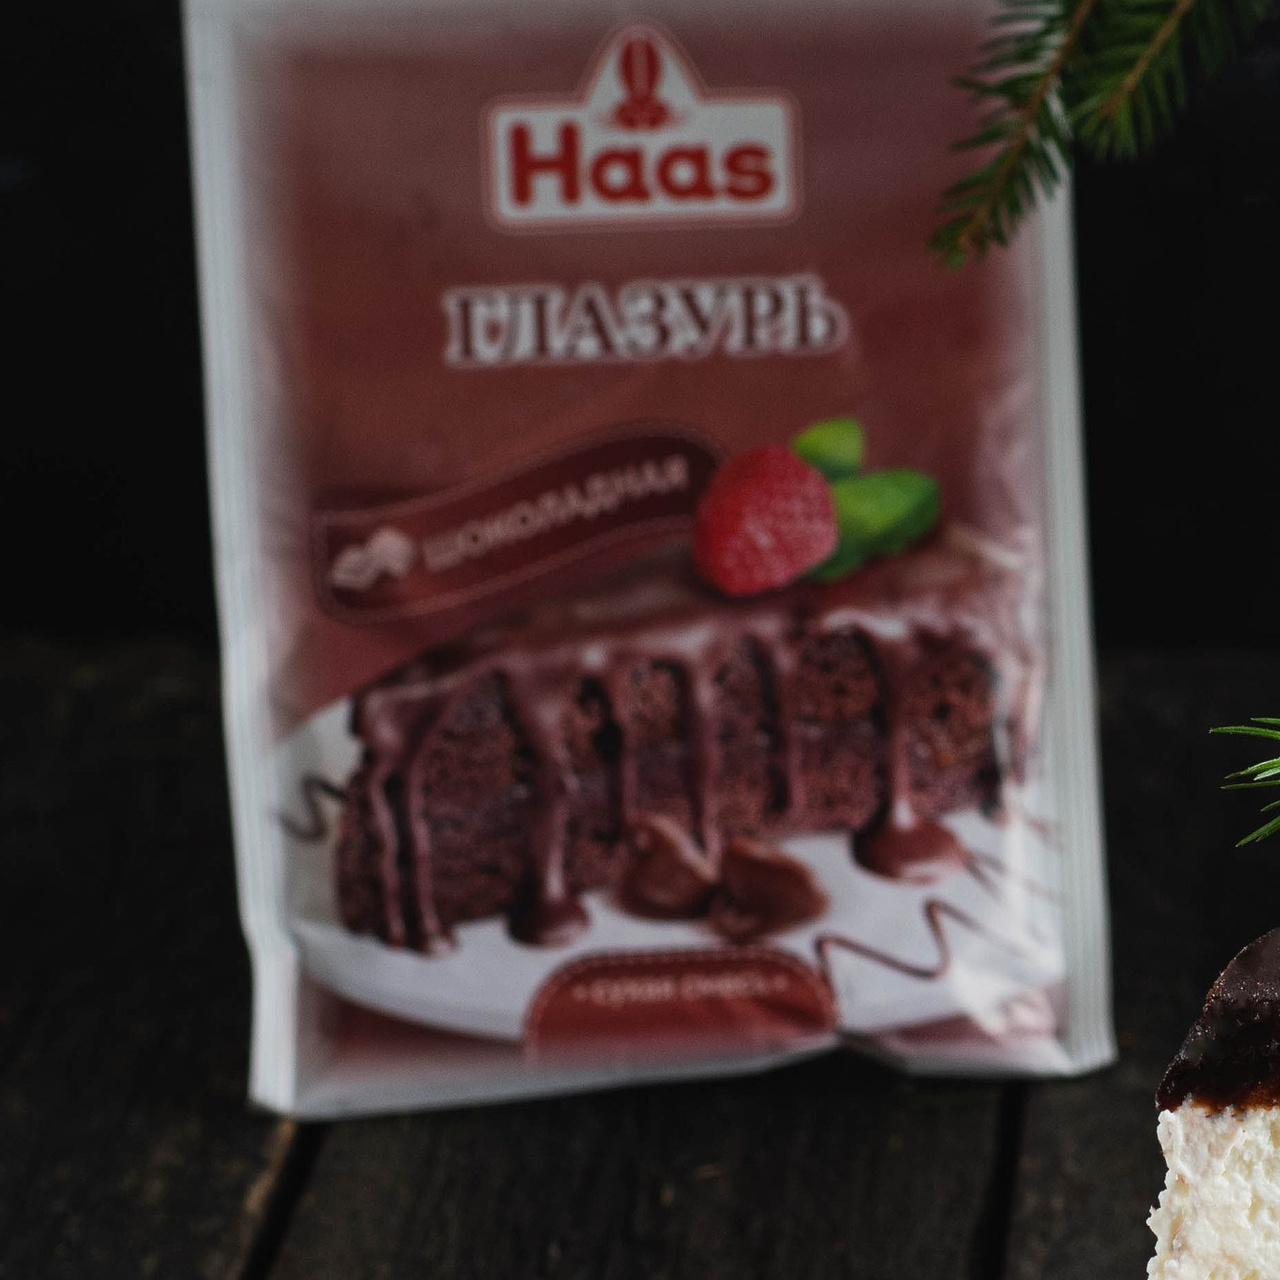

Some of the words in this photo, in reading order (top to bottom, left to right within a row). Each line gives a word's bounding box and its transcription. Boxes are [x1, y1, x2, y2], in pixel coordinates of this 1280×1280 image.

[510, 121, 774, 207] Haas
[446, 275, 848, 366] ГЛАЗУРЬ
[422, 454, 690, 570] ШОКОЛАДНАЯ
